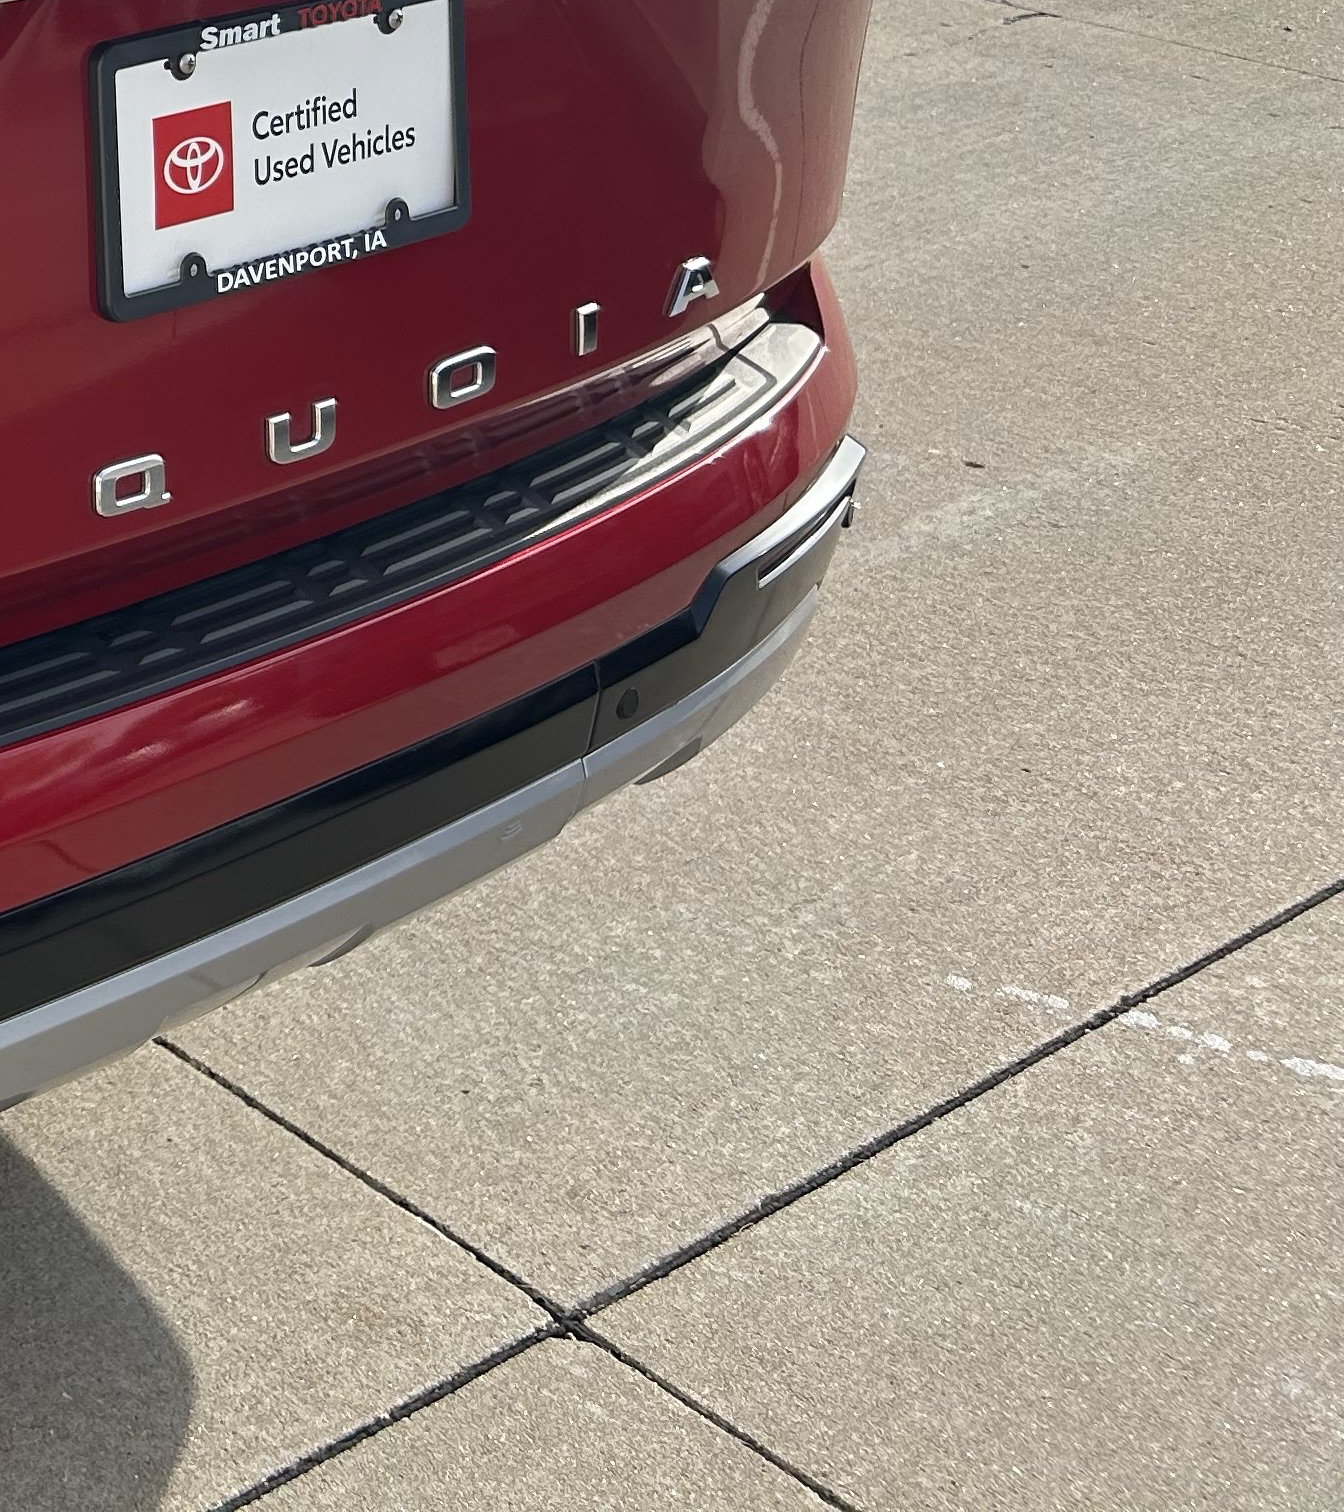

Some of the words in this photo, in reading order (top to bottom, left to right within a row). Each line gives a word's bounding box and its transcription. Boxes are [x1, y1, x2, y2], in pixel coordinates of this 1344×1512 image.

[200, 13, 281, 50] Smart
[251, 87, 357, 140] Certified
[254, 142, 315, 186] Used
[320, 124, 416, 169] Vehicles
[216, 237, 358, 293] DAVENPORT,
[364, 230, 387, 252] IA
